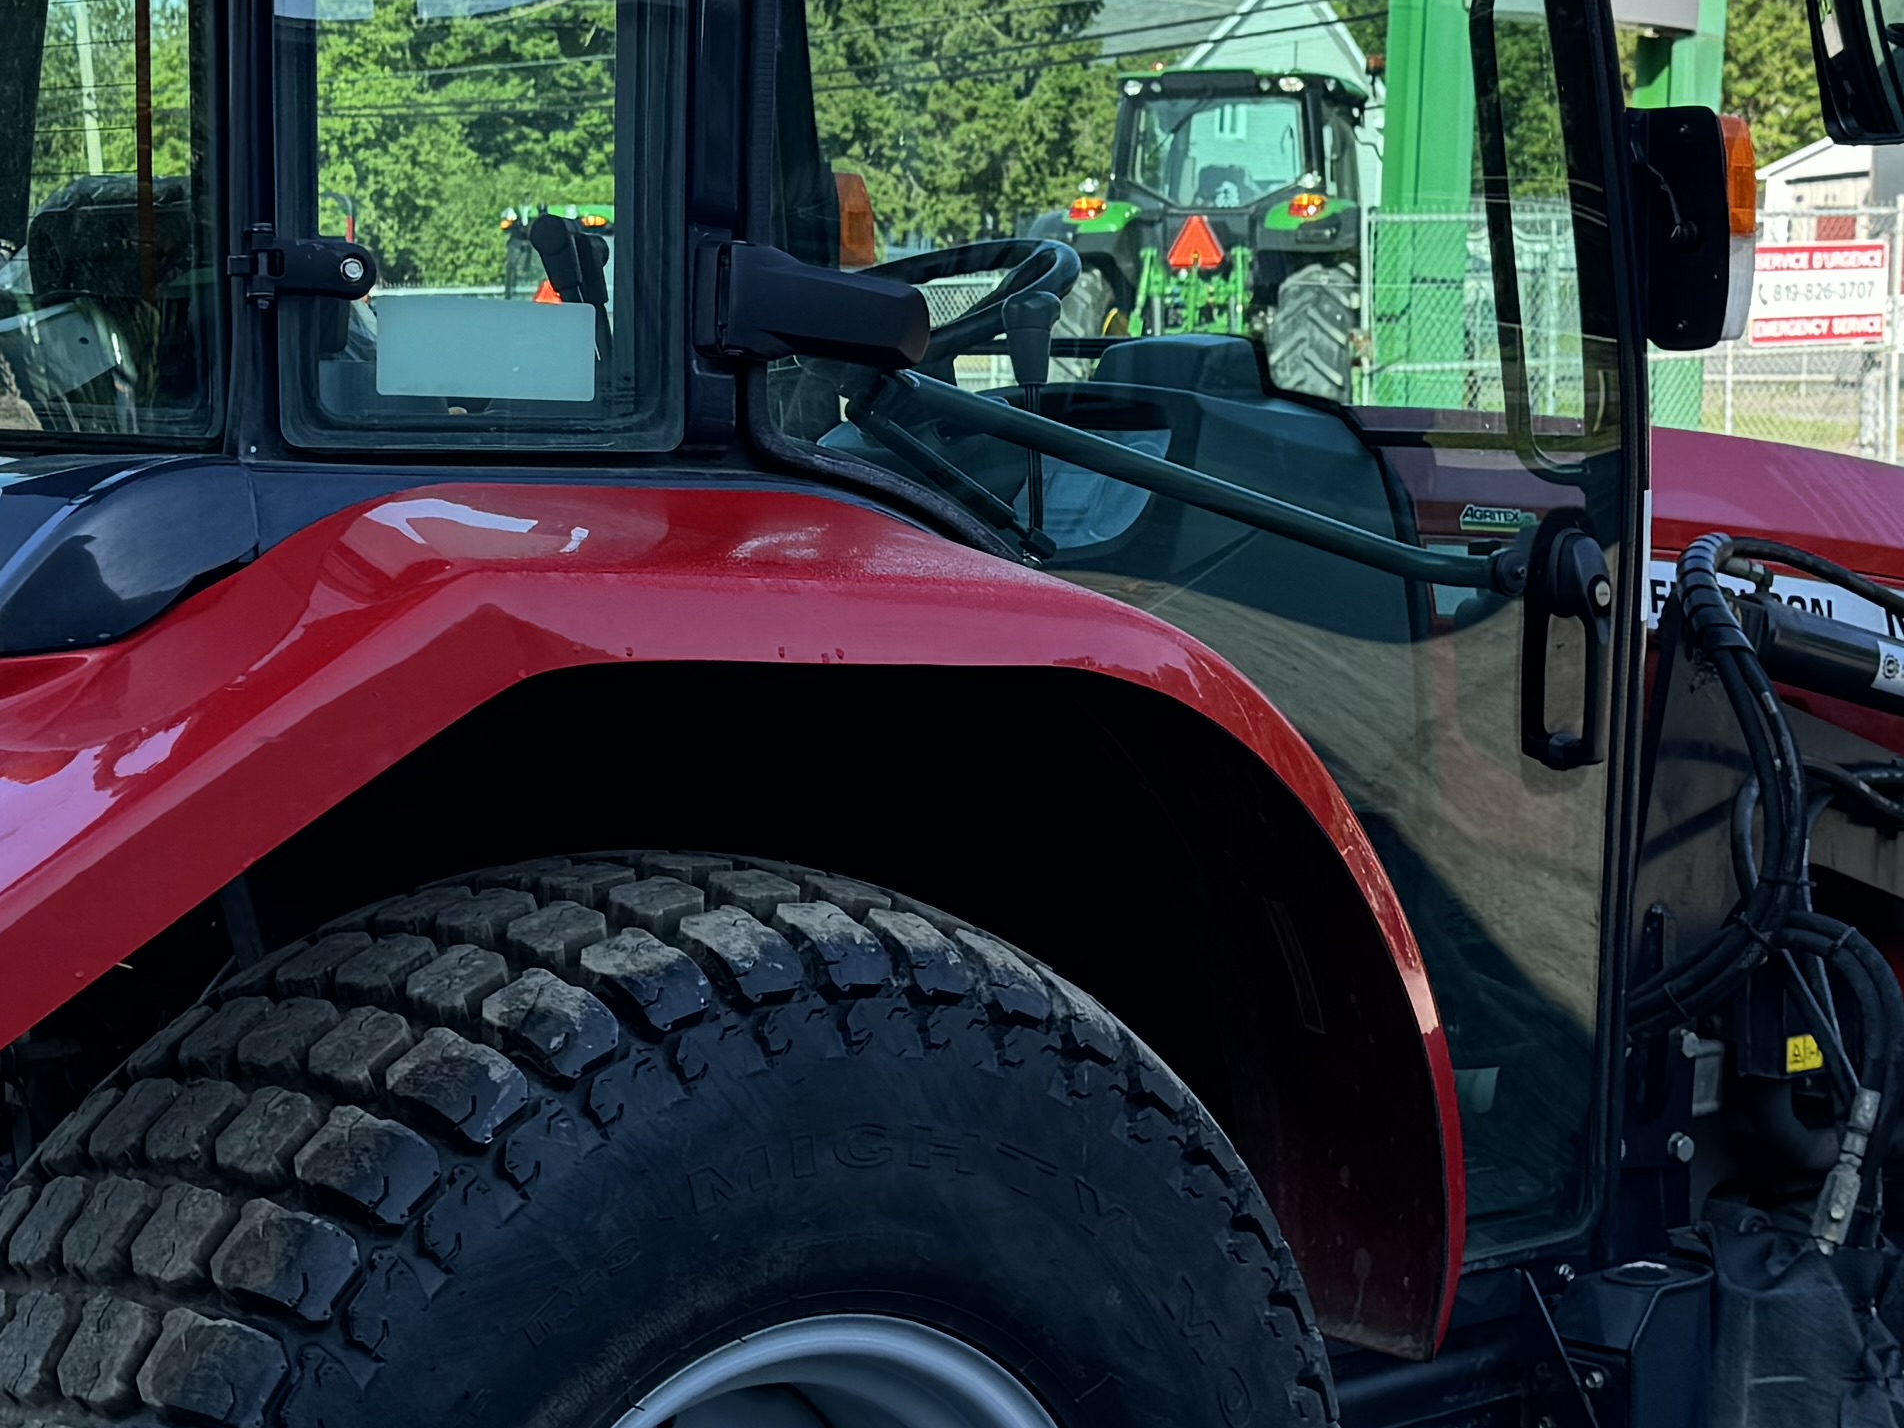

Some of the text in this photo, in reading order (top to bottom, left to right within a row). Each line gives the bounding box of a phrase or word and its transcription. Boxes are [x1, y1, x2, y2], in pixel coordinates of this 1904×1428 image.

[1755, 251, 1810, 271] SERVICE
[1754, 315, 1883, 339] EMERGENCY SERVICE
[1461, 505, 1520, 522] AGRITEX
